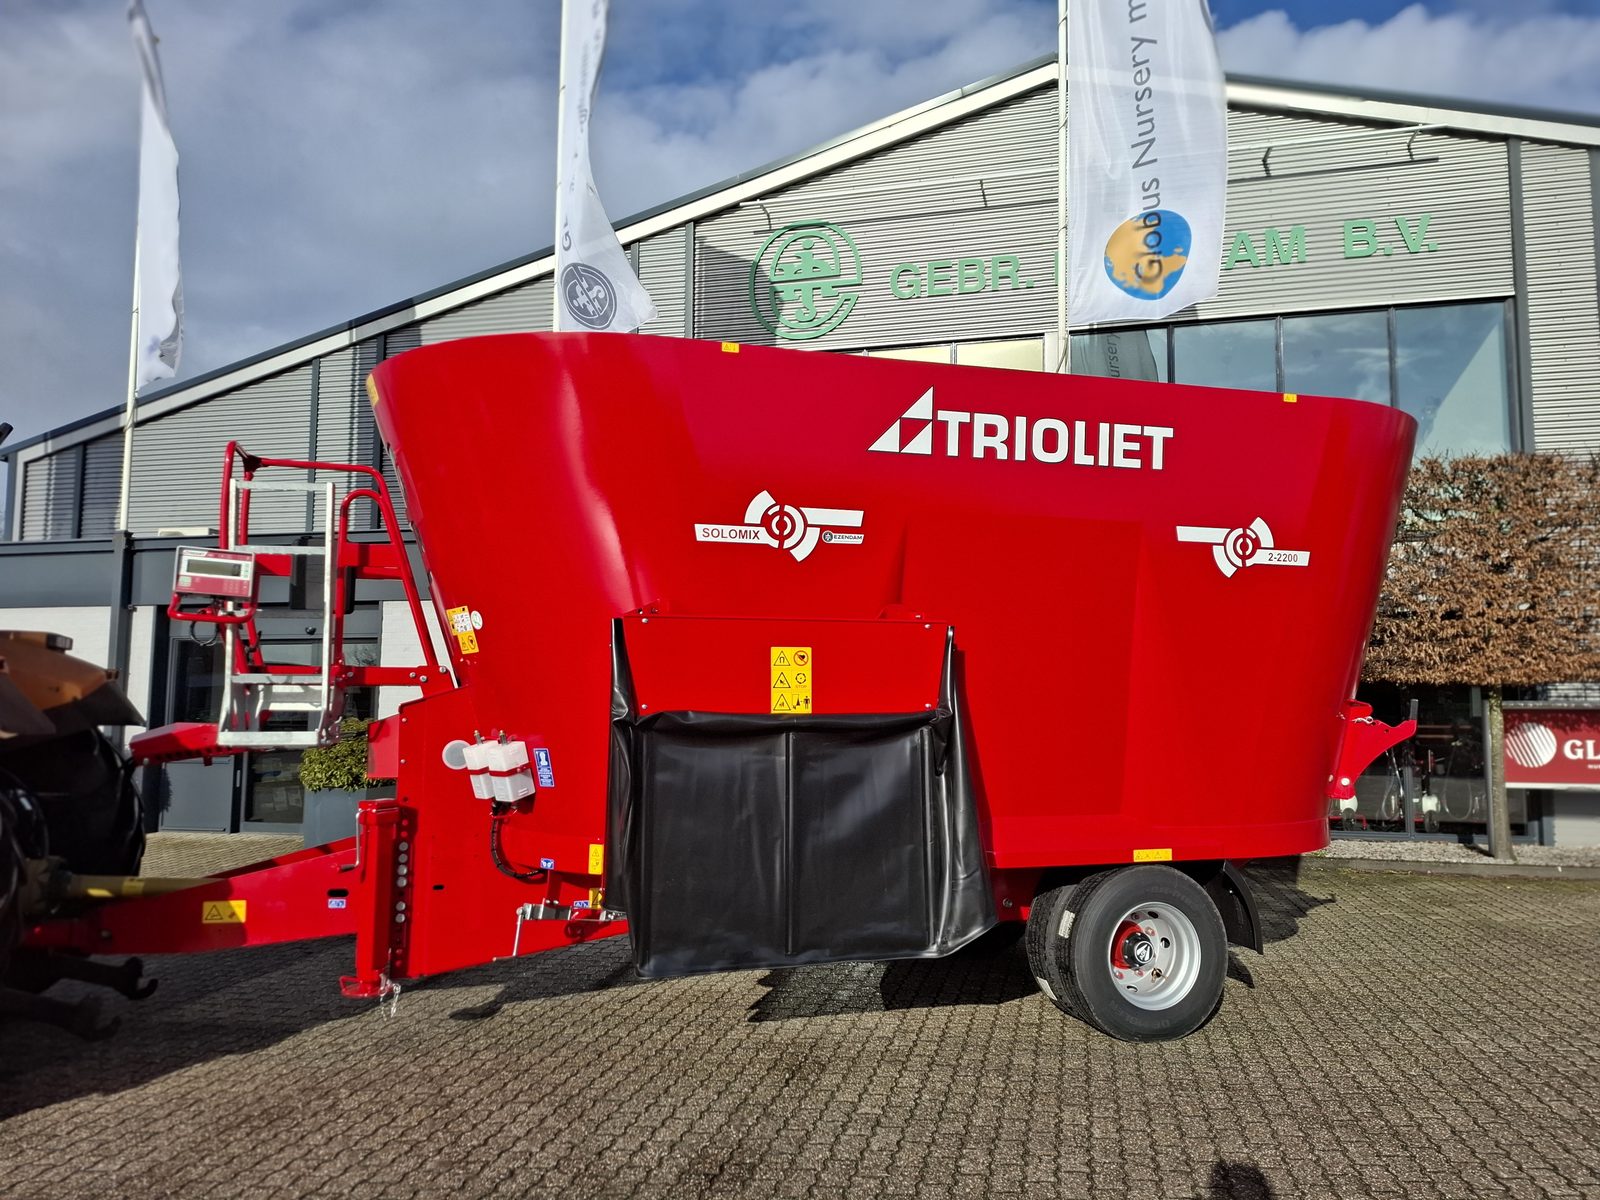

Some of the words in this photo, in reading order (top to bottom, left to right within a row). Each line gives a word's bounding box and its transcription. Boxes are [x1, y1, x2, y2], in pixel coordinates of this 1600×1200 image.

[1130, 36, 1158, 170] Nursery
[889, 254, 1035, 300] GEBR.
[1344, 213, 1438, 259] B.V.
[1135, 177, 1164, 284] Globus
[936, 409, 1175, 471] TRIOLIET
[701, 527, 761, 541] SOLOMIX
[1267, 552, 1299, 563] 2-2200
